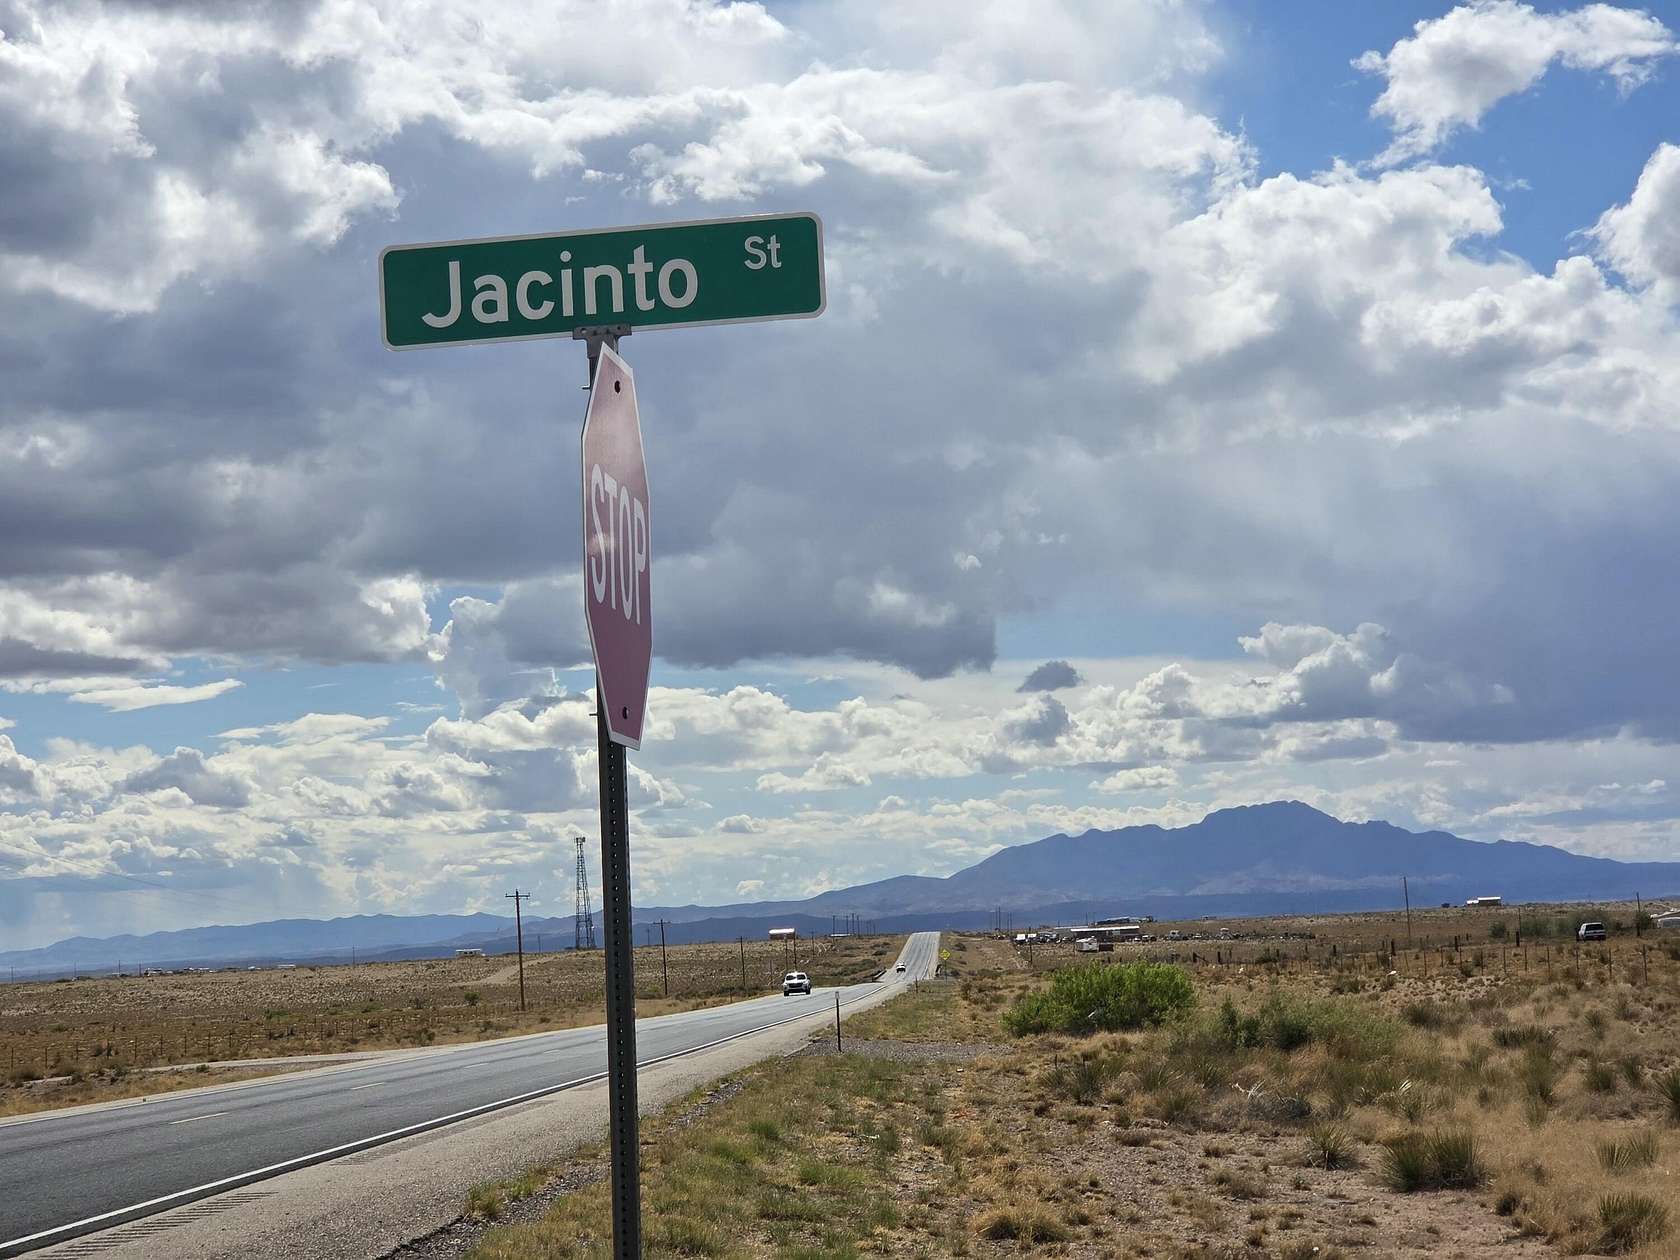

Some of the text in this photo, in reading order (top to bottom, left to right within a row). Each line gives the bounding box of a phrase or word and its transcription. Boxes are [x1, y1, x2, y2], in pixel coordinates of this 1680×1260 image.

[422, 234, 782, 329] Jacinto St
[592, 464, 646, 624] STOP
